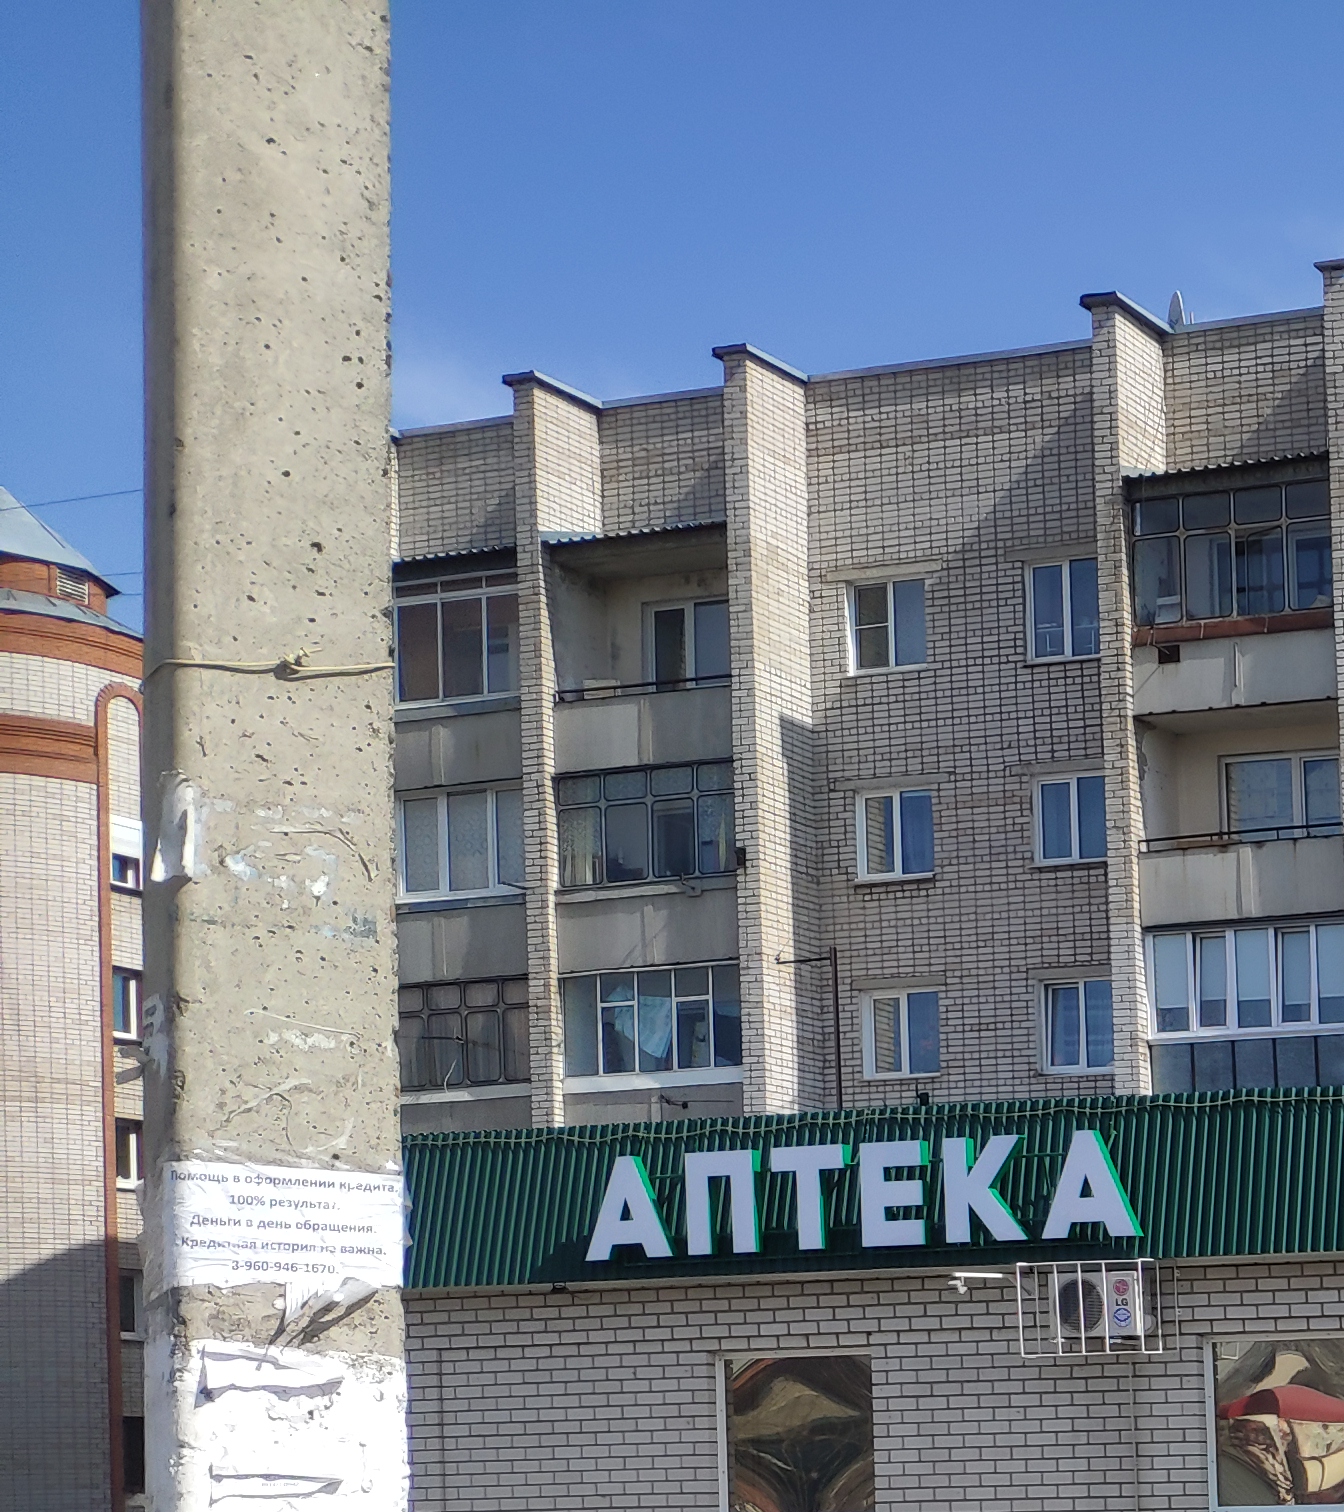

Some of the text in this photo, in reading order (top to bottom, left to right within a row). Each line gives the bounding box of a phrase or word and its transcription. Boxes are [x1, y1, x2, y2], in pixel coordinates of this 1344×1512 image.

[170, 1169, 228, 1185] Помощь
[233, 1174, 240, 1183] в
[244, 1173, 335, 1188] оформлении
[228, 1194, 266, 1207] 100%
[585, 1129, 1143, 1262] АПТЕКА
[190, 1214, 241, 1228] Деньги
[257, 1219, 291, 1231] день
[295, 1219, 378, 1234] обращения.
[340, 1245, 387, 1256] важна.
[1115, 1298, 1129, 1307] LG
